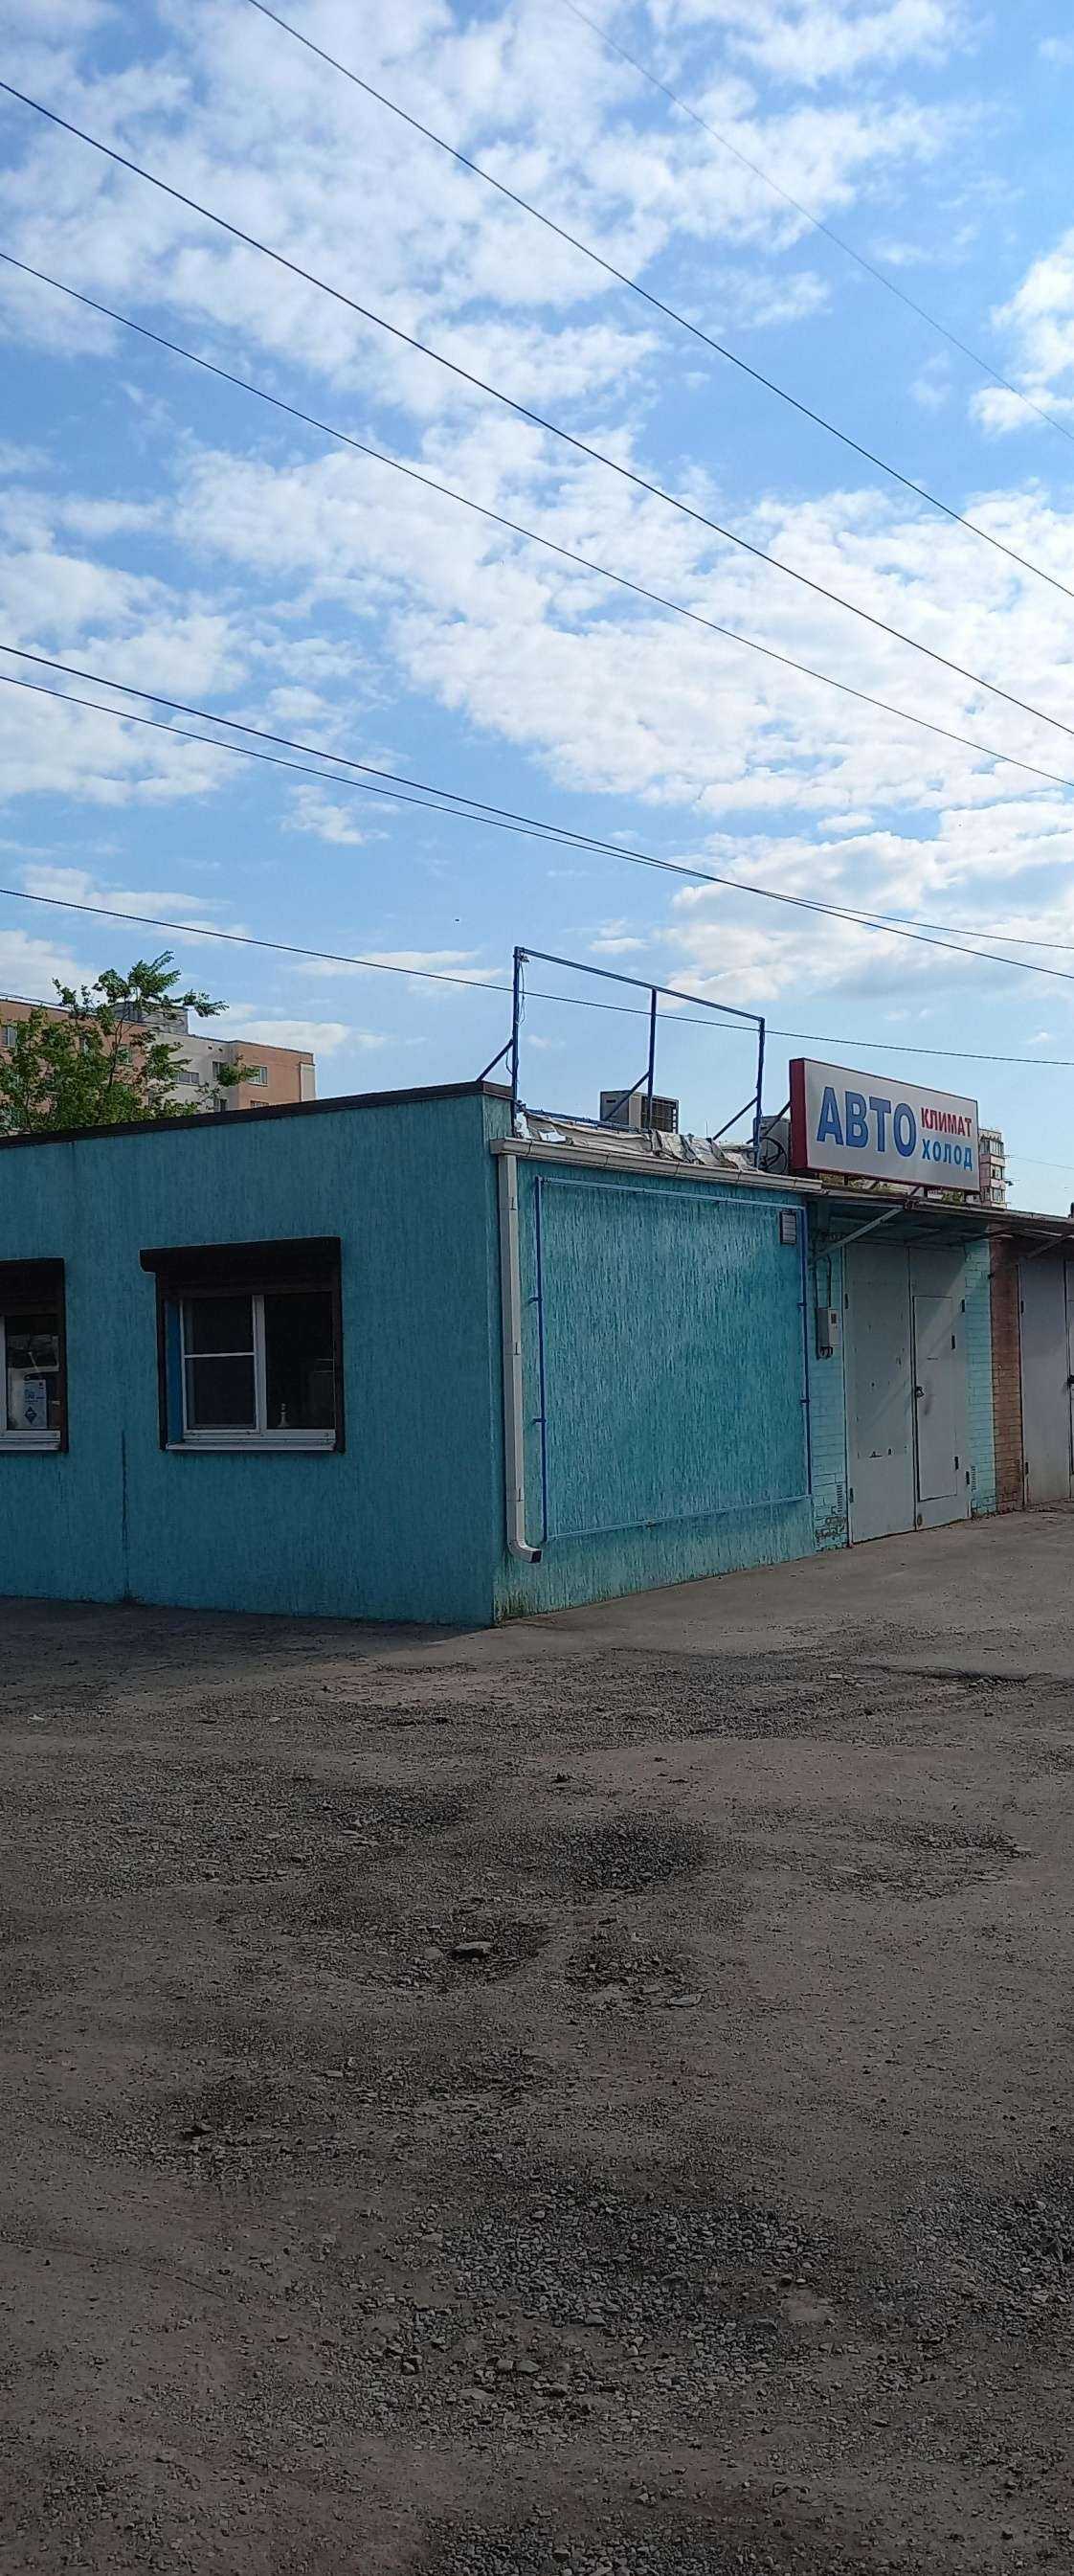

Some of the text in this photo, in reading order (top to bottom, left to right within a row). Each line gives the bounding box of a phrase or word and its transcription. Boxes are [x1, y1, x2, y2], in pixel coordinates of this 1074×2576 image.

[817, 1086, 917, 1157] АВТО
[921, 1107, 973, 1138] КЛИМАТ
[921, 1139, 973, 1171] ХОЛОД
